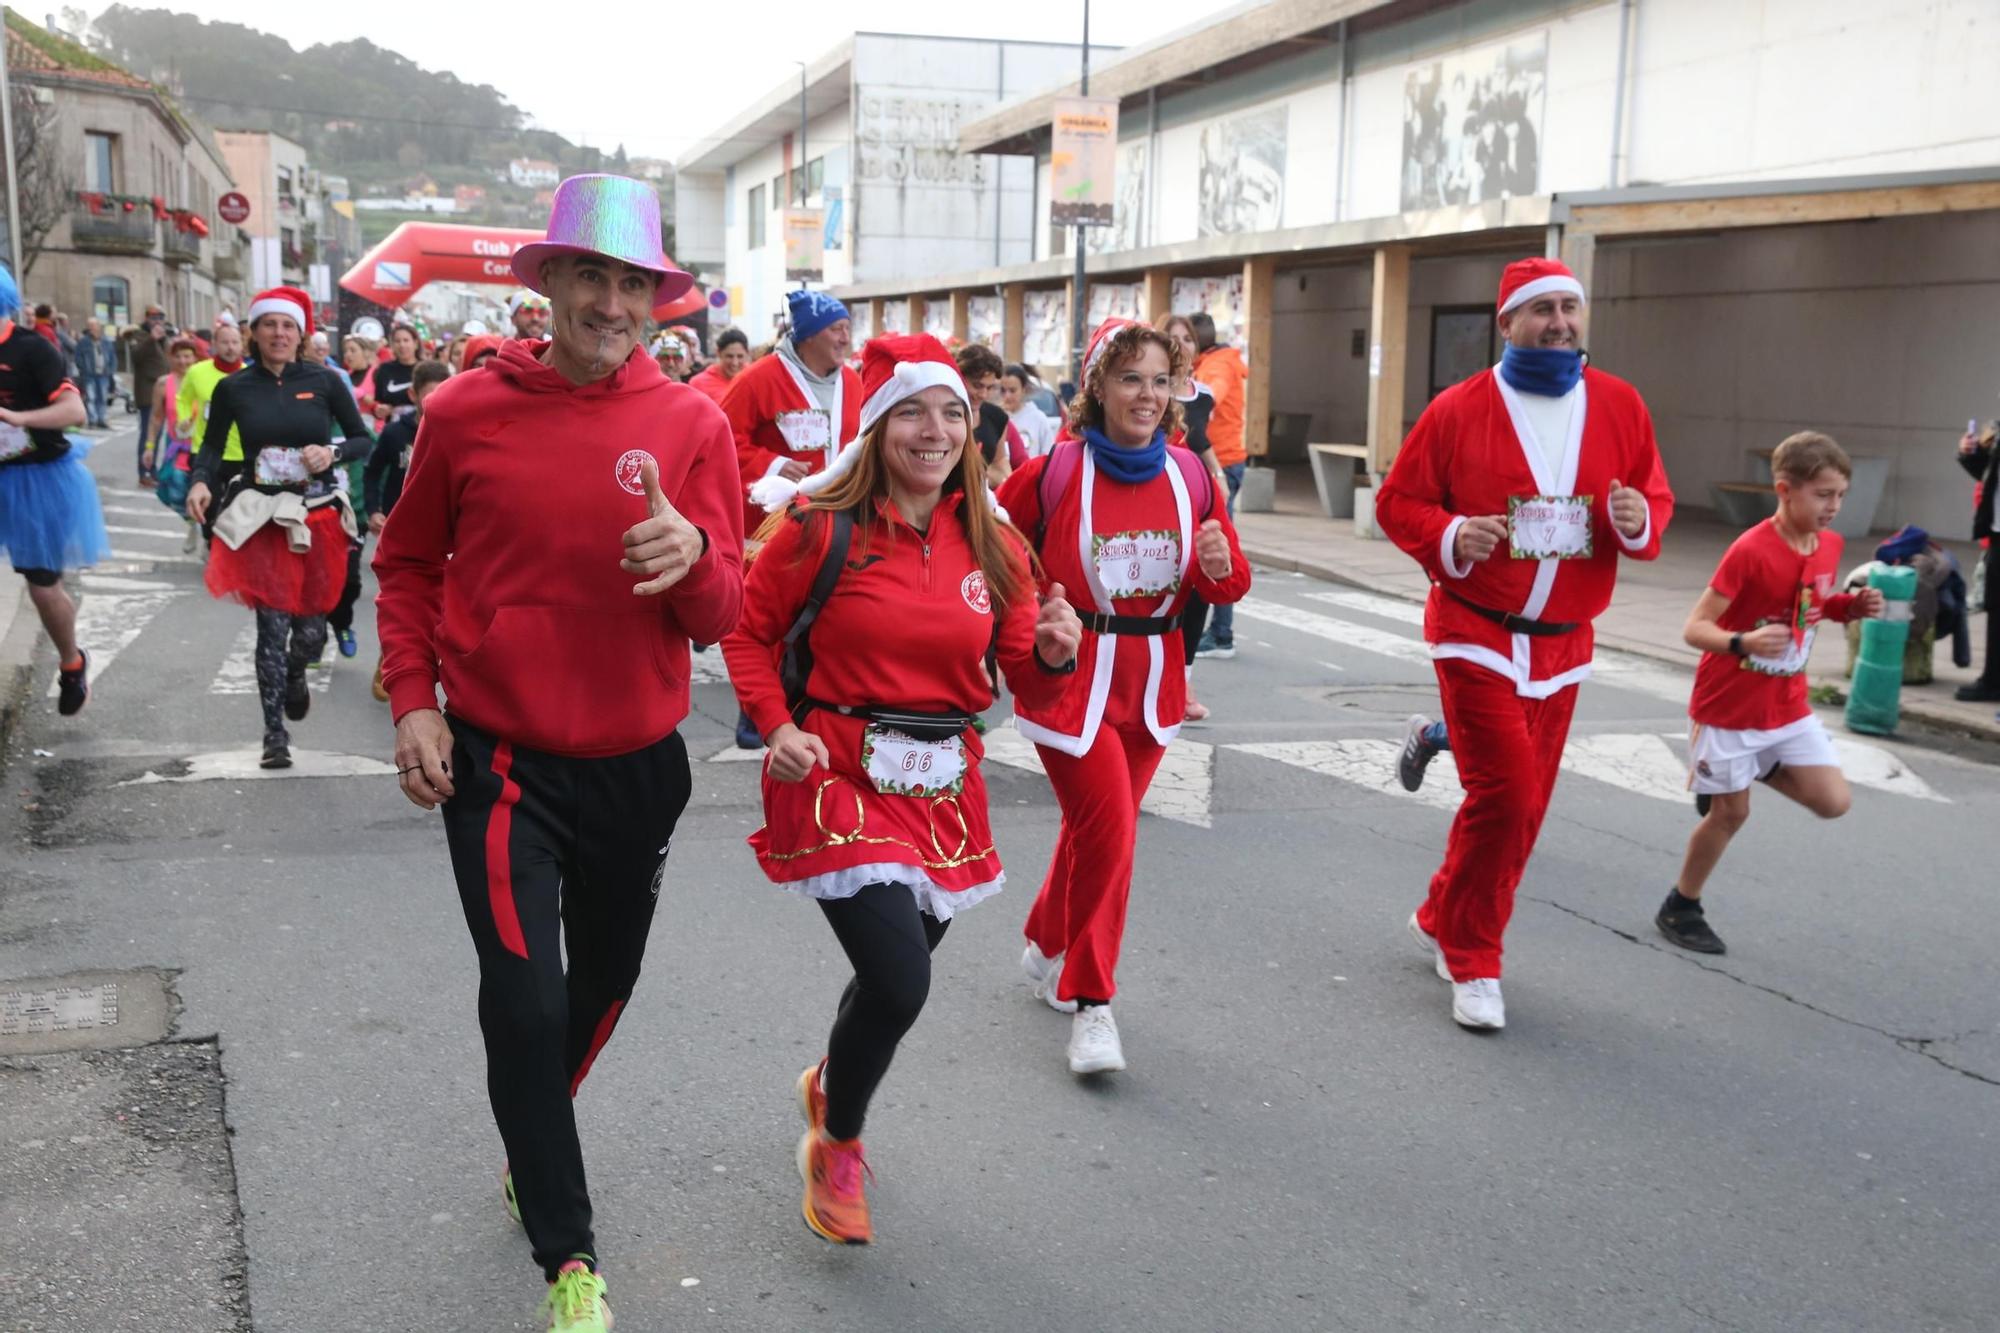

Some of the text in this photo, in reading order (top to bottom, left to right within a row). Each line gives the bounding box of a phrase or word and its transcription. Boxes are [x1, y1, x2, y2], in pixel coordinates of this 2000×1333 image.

[472, 239, 510, 256] Club
[483, 260, 514, 276] Cor
[1127, 561, 1140, 580] 8
[901, 750, 932, 772] 66
